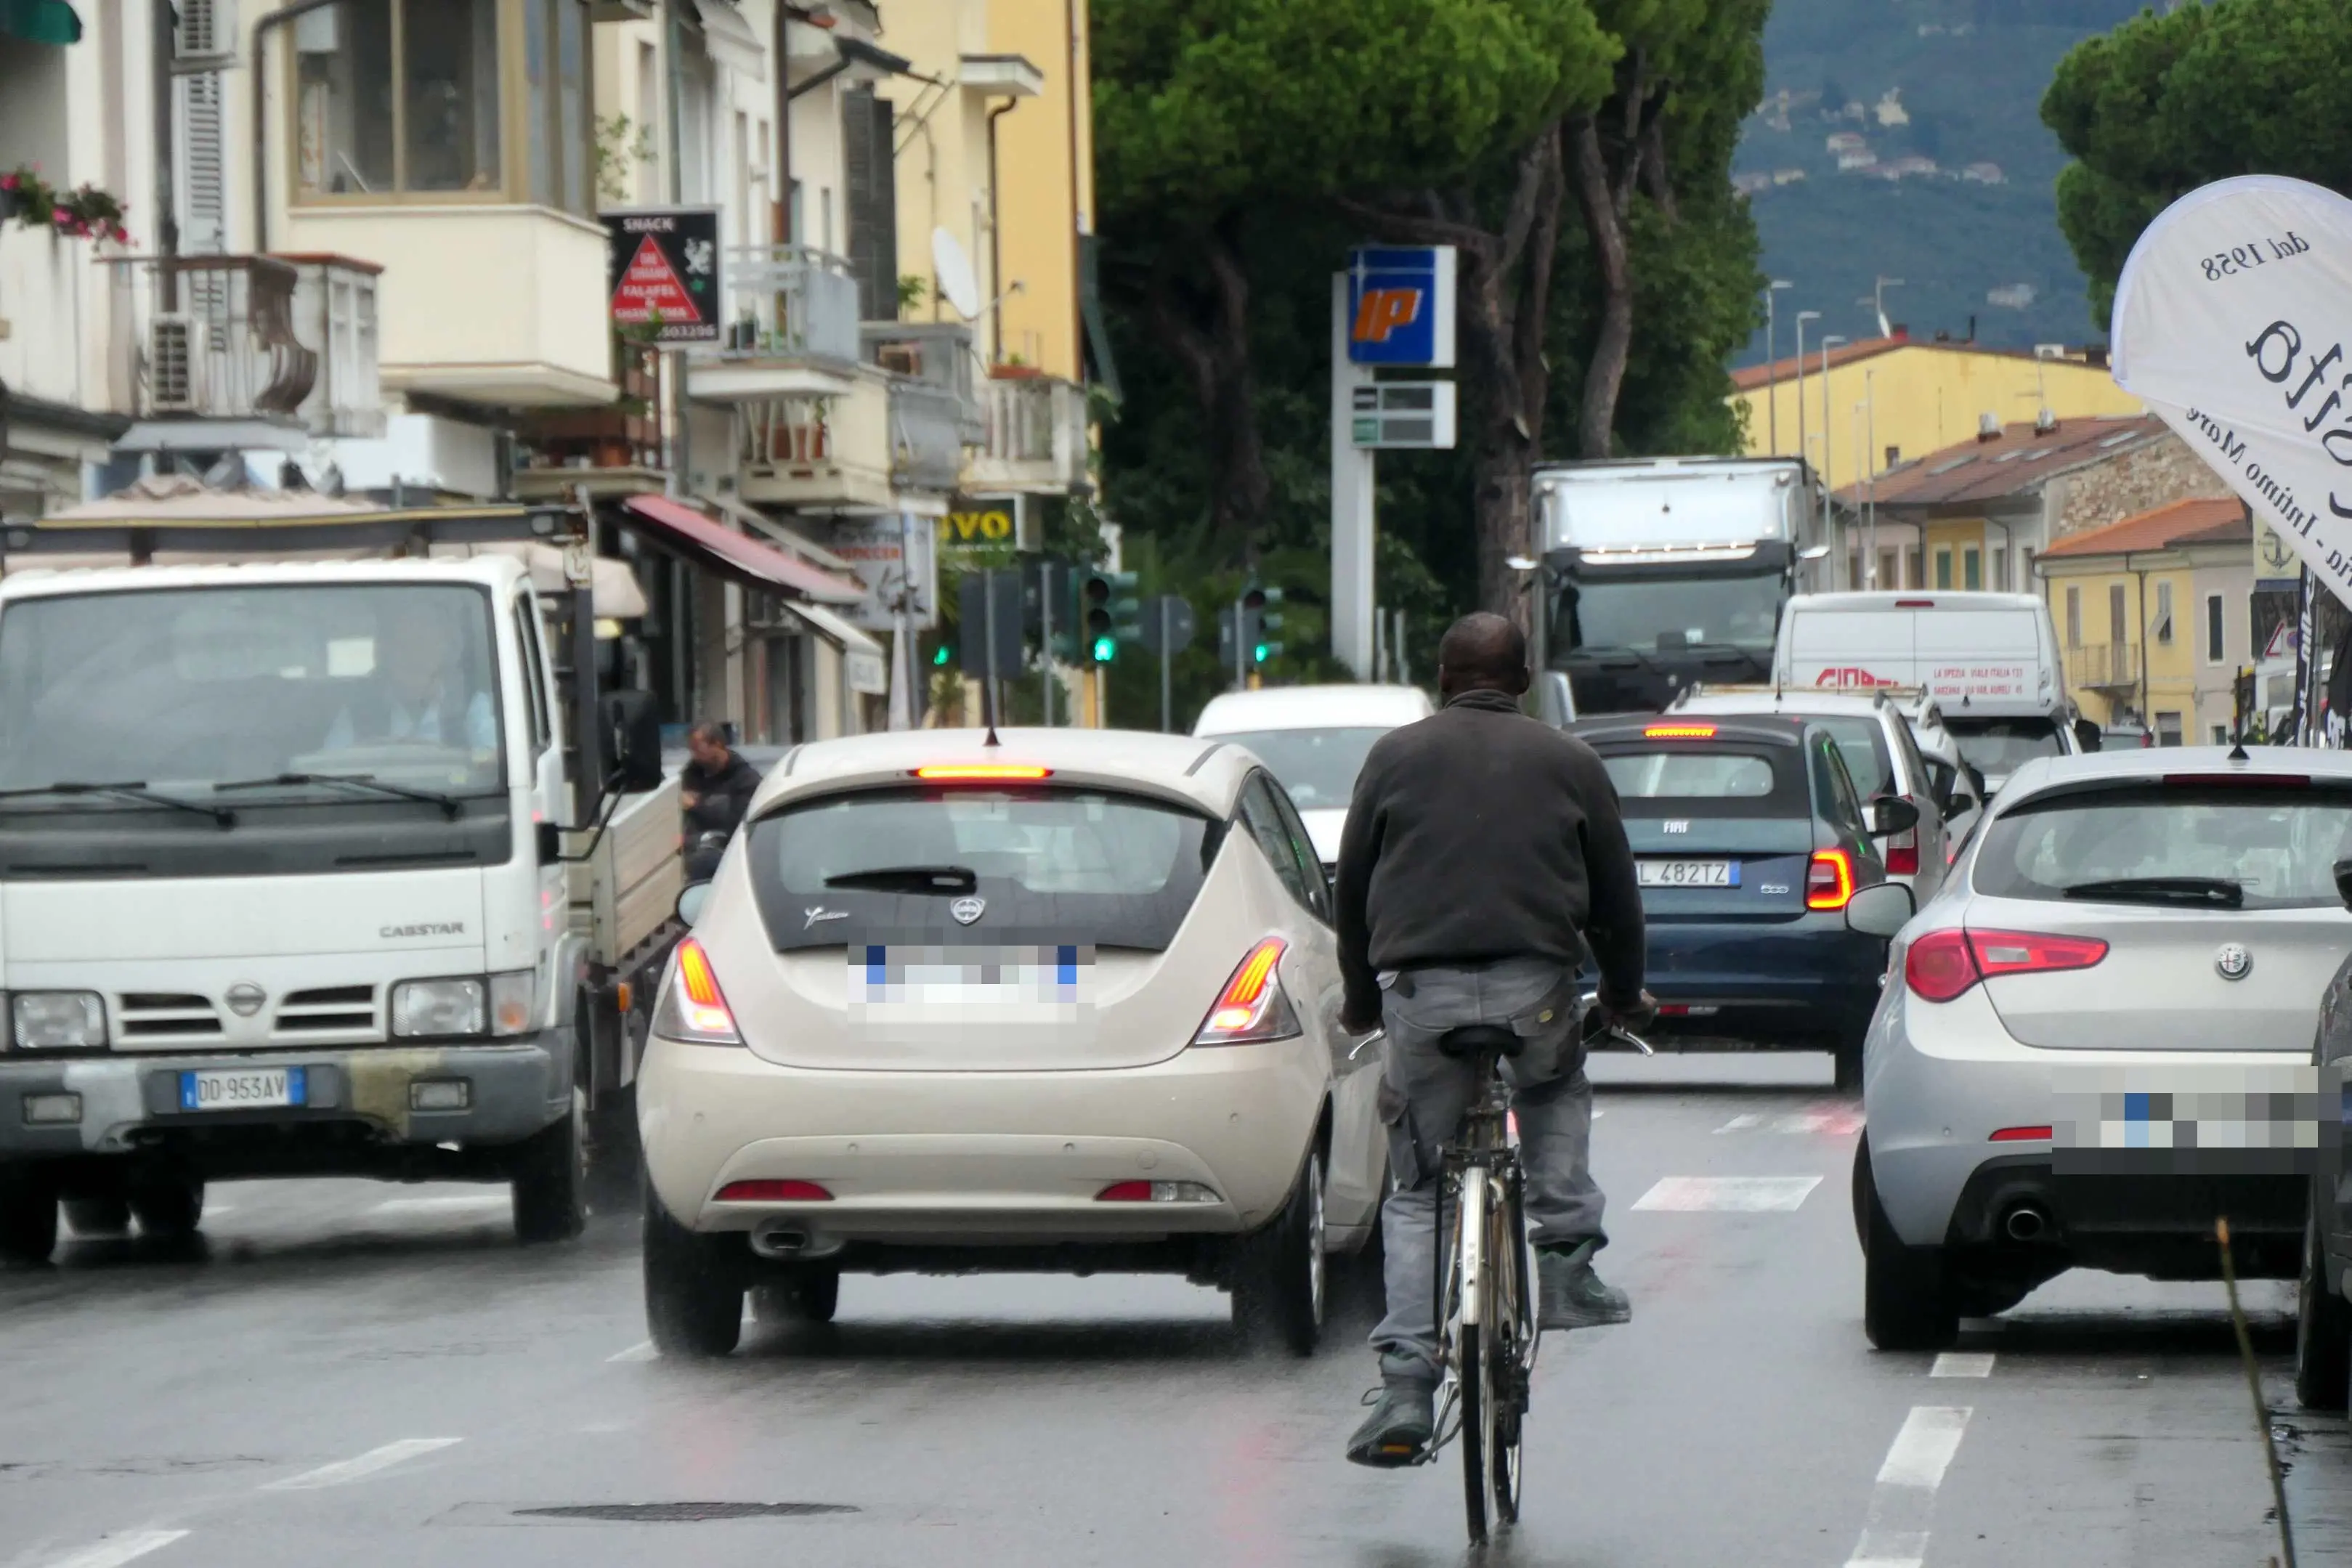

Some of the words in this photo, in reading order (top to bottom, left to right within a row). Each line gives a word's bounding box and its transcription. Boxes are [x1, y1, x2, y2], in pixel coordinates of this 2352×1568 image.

[623, 218, 674, 232] SNACK
[1352, 288, 1424, 343] IP
[1663, 821, 1690, 834] FIAT
[1660, 863, 1727, 884] 482TZ
[379, 922, 465, 938] CABSTAR
[197, 1078, 221, 1102] DD
[227, 1076, 285, 1100] 953AV
